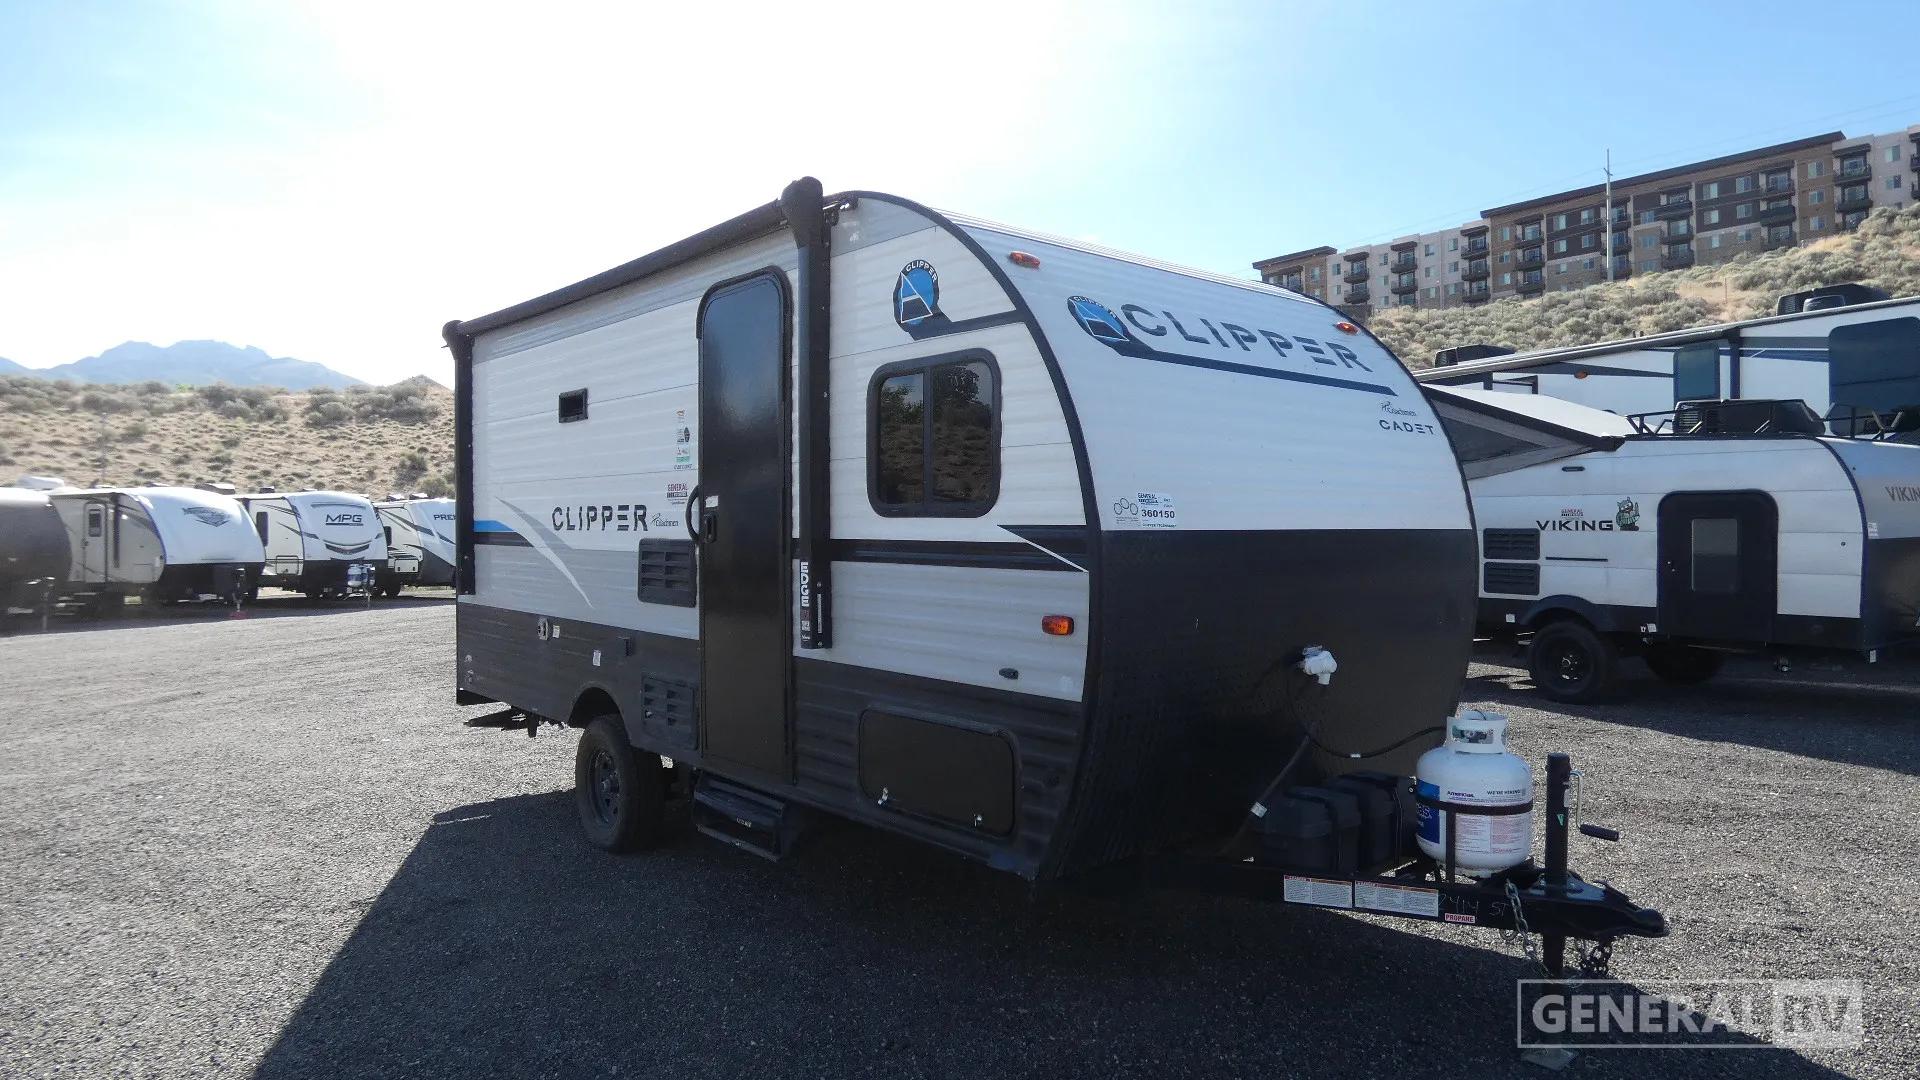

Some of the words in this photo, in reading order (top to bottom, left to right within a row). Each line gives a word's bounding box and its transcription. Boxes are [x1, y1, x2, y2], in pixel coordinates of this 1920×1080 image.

[906, 260, 938, 283] CLIPPER
[1120, 303, 1373, 373] CLIPPER
[1379, 419, 1434, 434] CADET
[667, 483, 688, 492] GENERAL
[326, 514, 363, 523] MPG
[551, 504, 648, 531] CLIPPER
[1141, 509, 1175, 519] 360150
[1536, 520, 1614, 531] VIKING
[801, 561, 810, 607] EDGE
[1446, 914, 1474, 923] PROPANE
